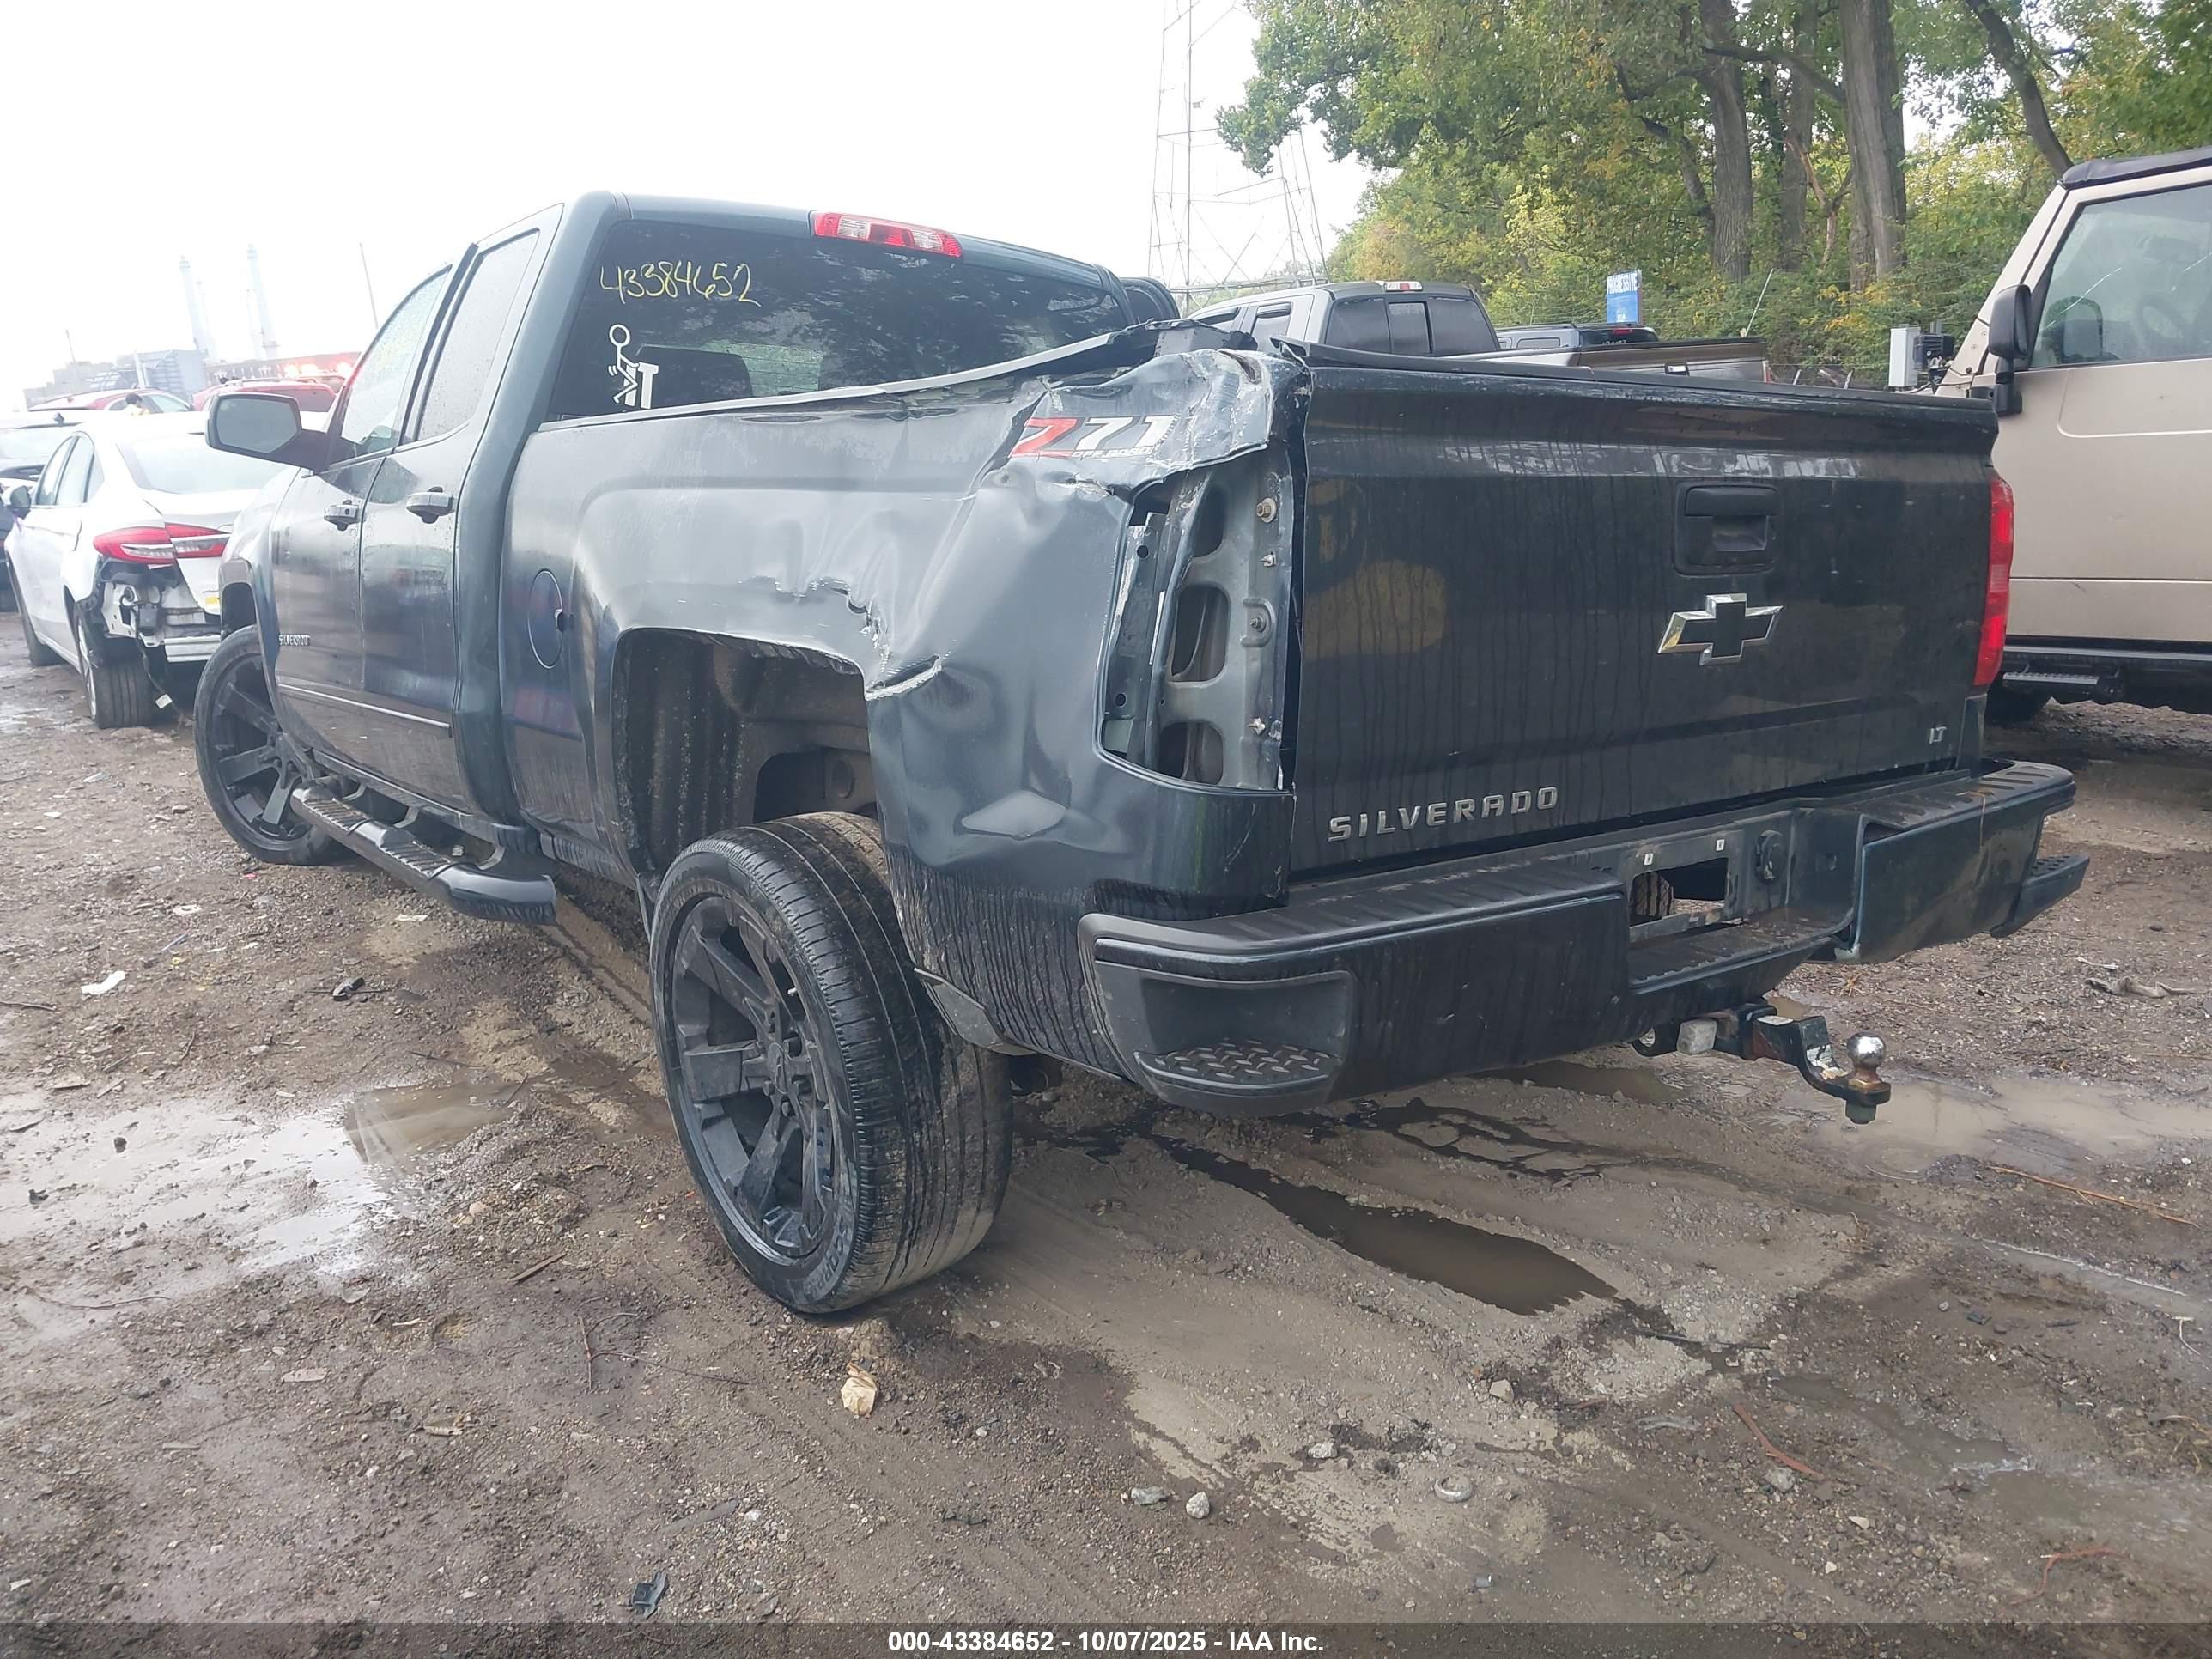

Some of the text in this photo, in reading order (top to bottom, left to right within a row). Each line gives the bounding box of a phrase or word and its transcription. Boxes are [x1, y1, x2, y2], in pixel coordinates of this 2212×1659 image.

[600, 260, 762, 307] 43384652
[1009, 414, 1176, 458] Z71
[1328, 786, 1558, 842] SILVERADO
